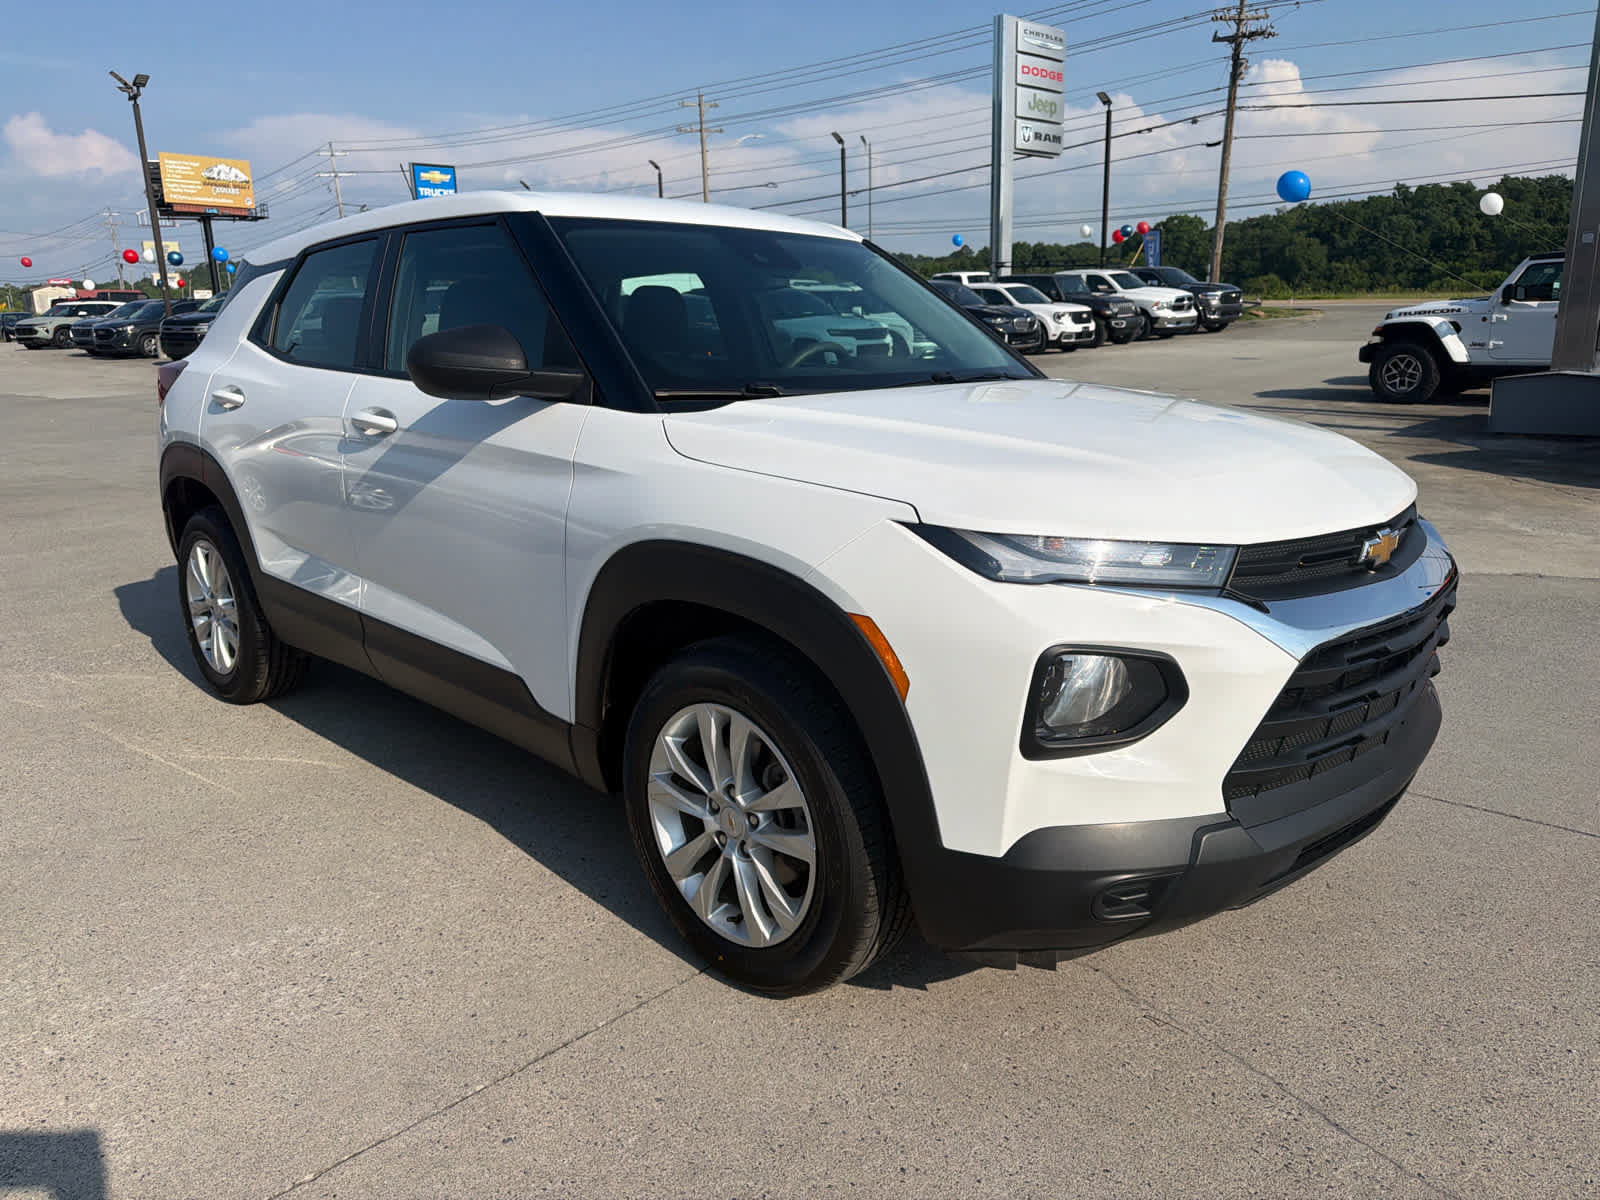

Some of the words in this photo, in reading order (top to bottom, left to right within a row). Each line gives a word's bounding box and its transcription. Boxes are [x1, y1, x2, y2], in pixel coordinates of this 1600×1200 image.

[1023, 28, 1064, 43] CHRYSLER
[1021, 65, 1064, 82] DODGE
[1028, 93, 1057, 118] Jeep
[1034, 132, 1062, 145] RAM
[1398, 308, 1463, 318] RUBICON
